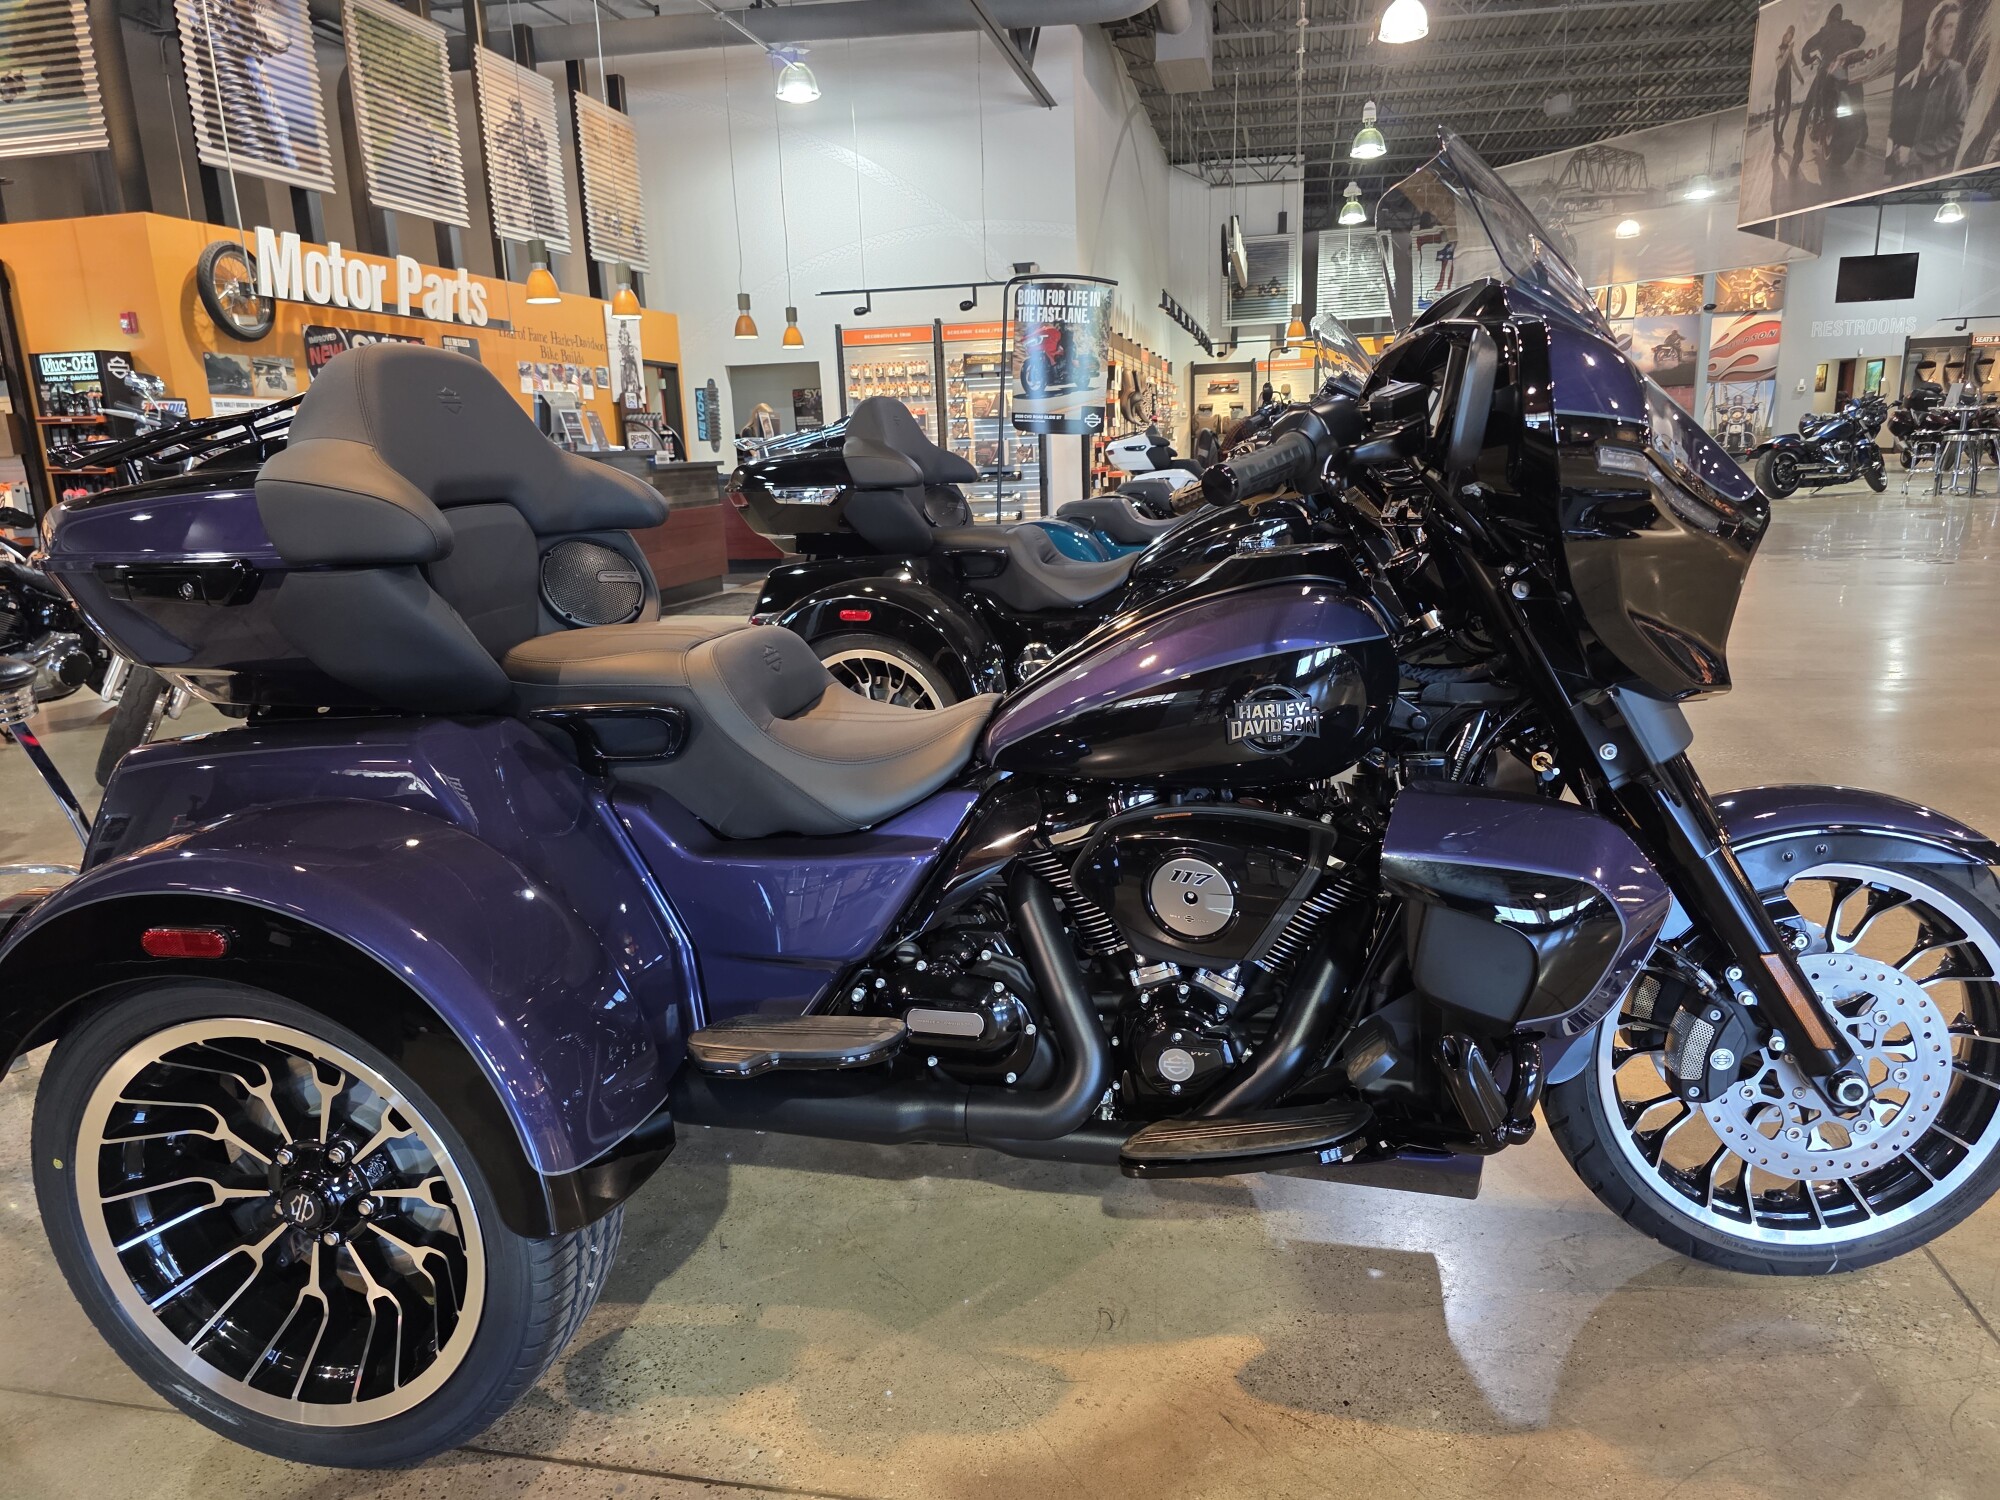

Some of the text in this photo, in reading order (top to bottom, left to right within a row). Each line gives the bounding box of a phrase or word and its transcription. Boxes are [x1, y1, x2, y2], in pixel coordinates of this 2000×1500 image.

[255, 226, 489, 327] Motor Parts
[1017, 288, 1102, 308] BORN FOR LIFE IN
[1017, 306, 1091, 324] THE FAST LANE.
[1811, 316, 1918, 338] RESTROOMS
[308, 332, 338, 345] IMPROVED
[528, 327, 548, 343] Fame
[550, 331, 607, 352] Harley-Davidson
[43, 355, 95, 373] Muc-Off
[309, 343, 344, 366] NEW
[540, 345, 585, 365] Bike Builds
[1239, 702, 1310, 719] HARLEY-
[1231, 715, 1317, 740] DAVIDSON
[1267, 734, 1282, 743] USA
[1169, 868, 1217, 887] 117
